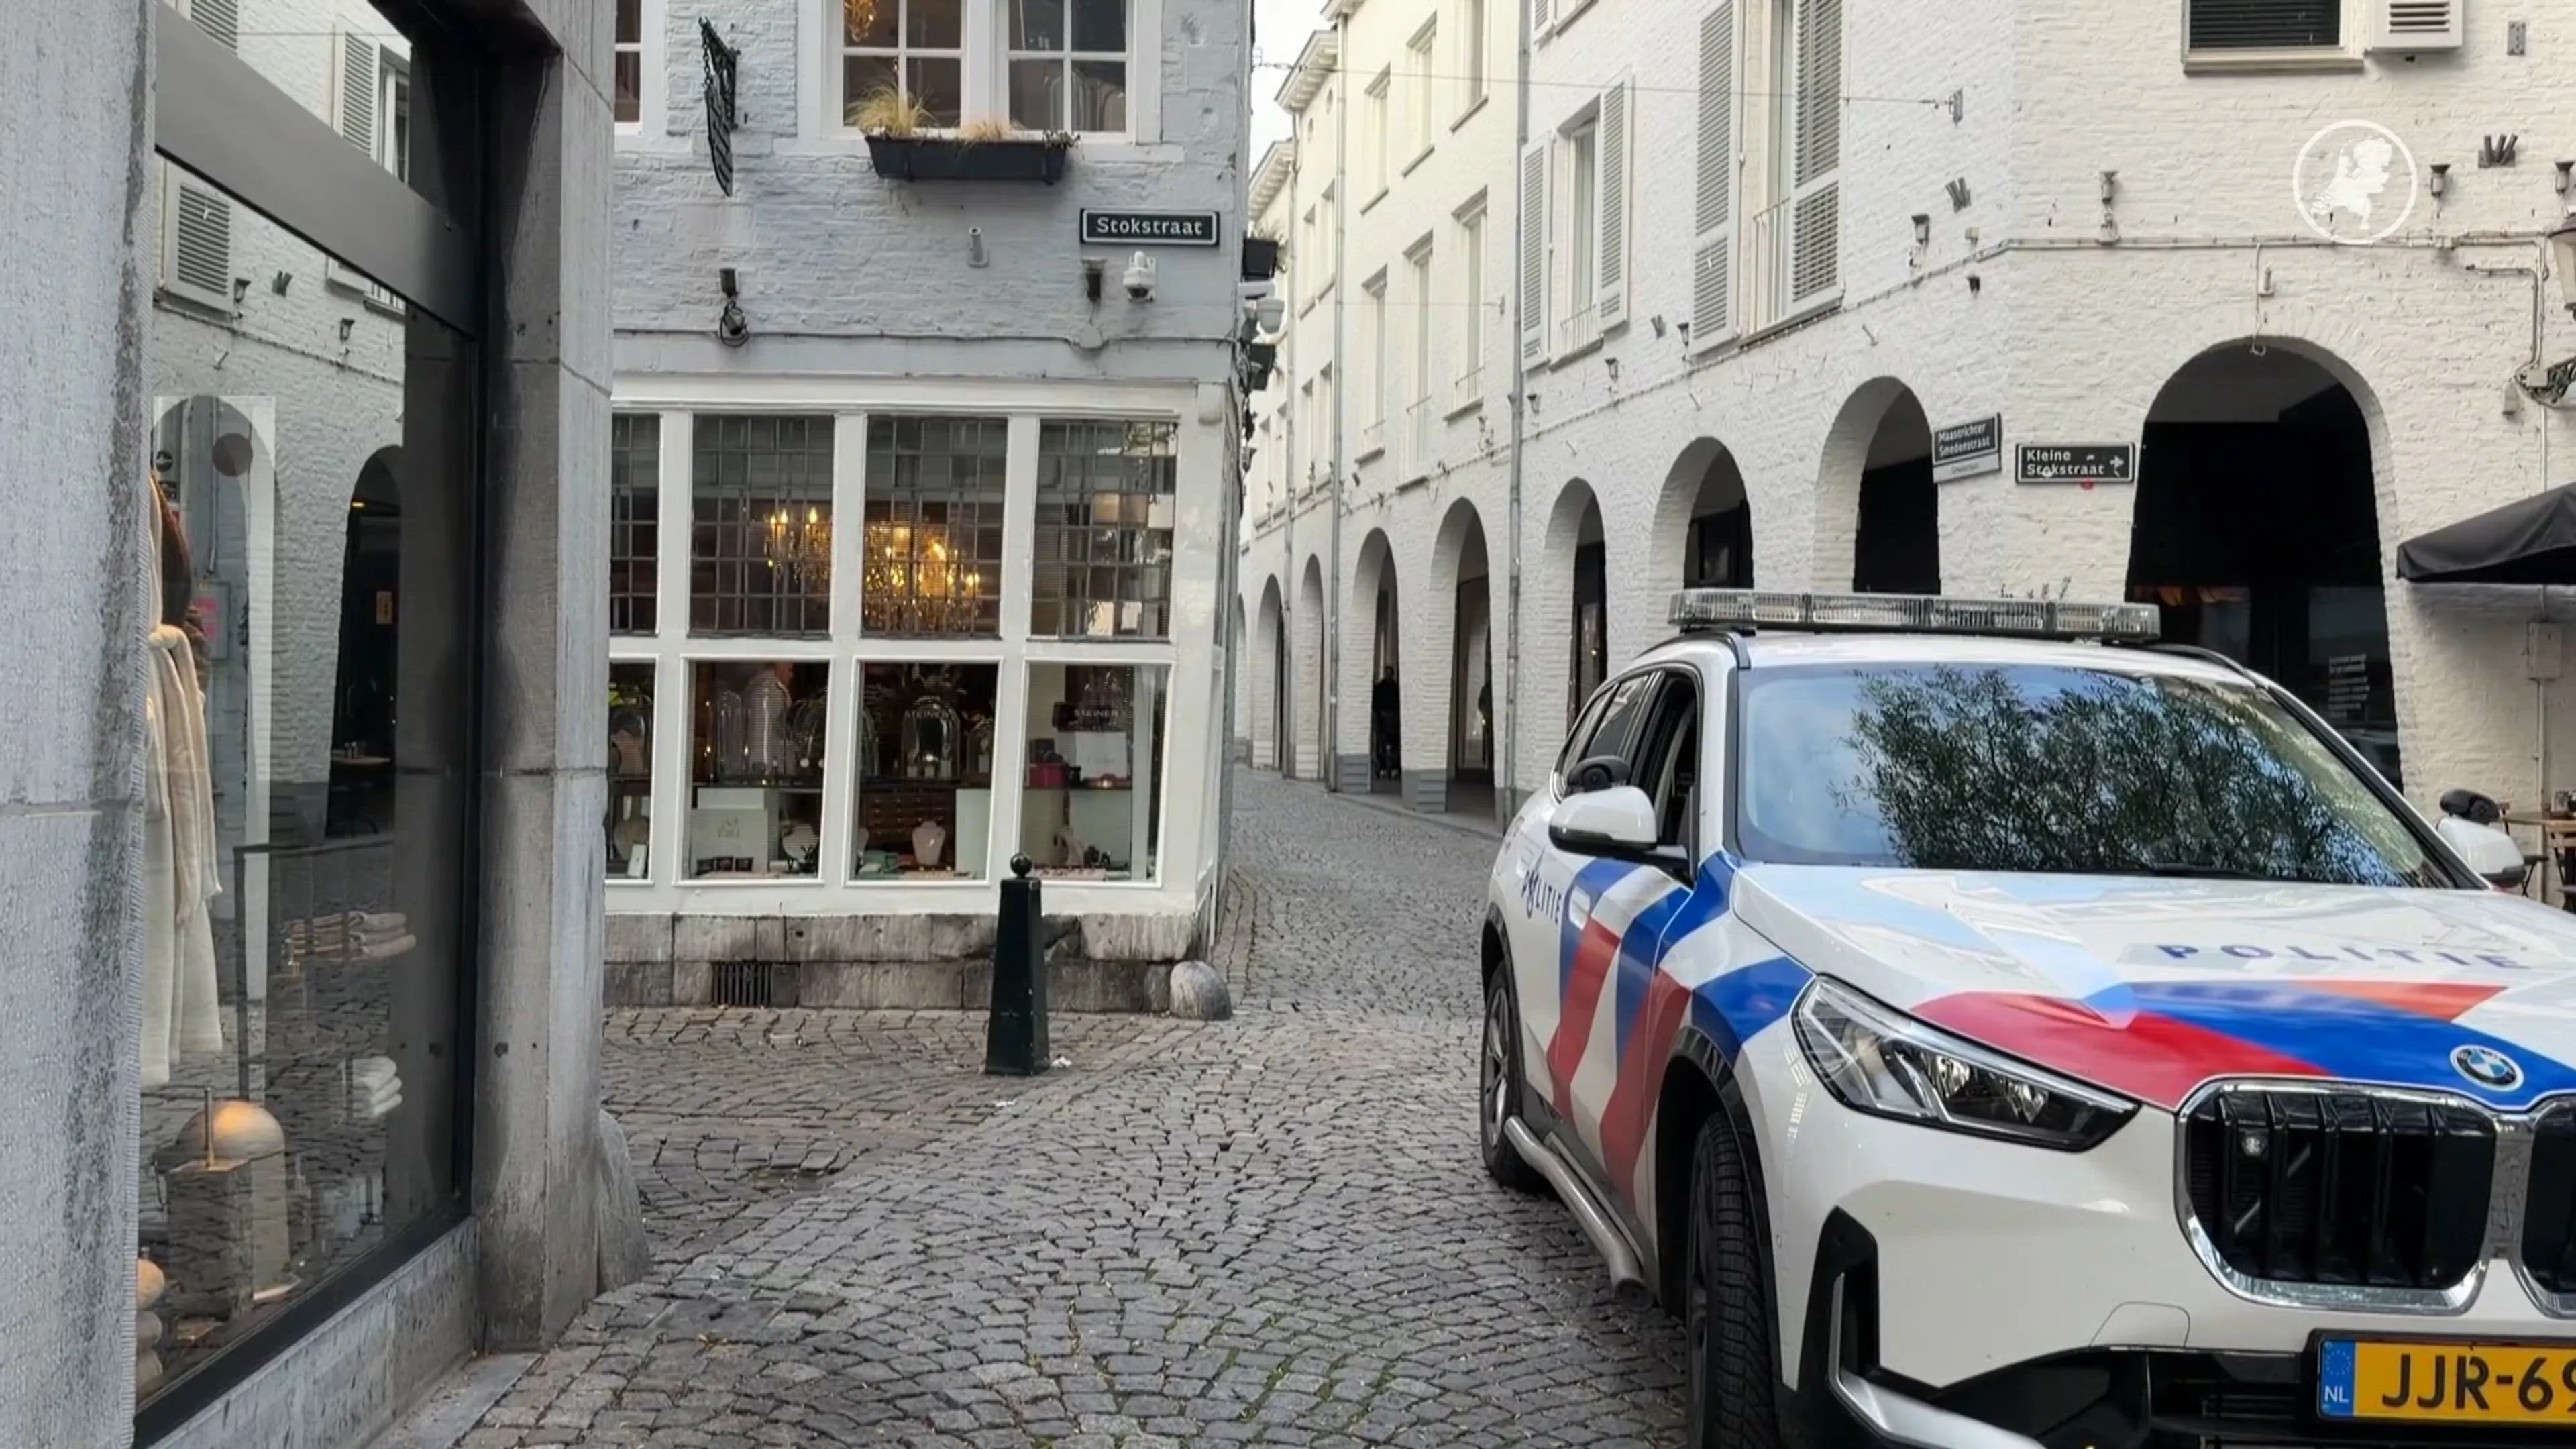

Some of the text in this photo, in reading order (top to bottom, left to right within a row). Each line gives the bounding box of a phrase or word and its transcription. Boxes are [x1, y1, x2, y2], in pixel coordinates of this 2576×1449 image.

[1097, 217, 1203, 235] Stokstraat
[1939, 423, 1986, 443] Maastrichter
[1939, 437, 1990, 458] Smedenstraat
[2027, 449, 2072, 462] Kleine
[2027, 463, 2105, 477] Stokstraat
[2156, 945, 2531, 970] POLITIE
[2324, 1385, 2349, 1403] NL
